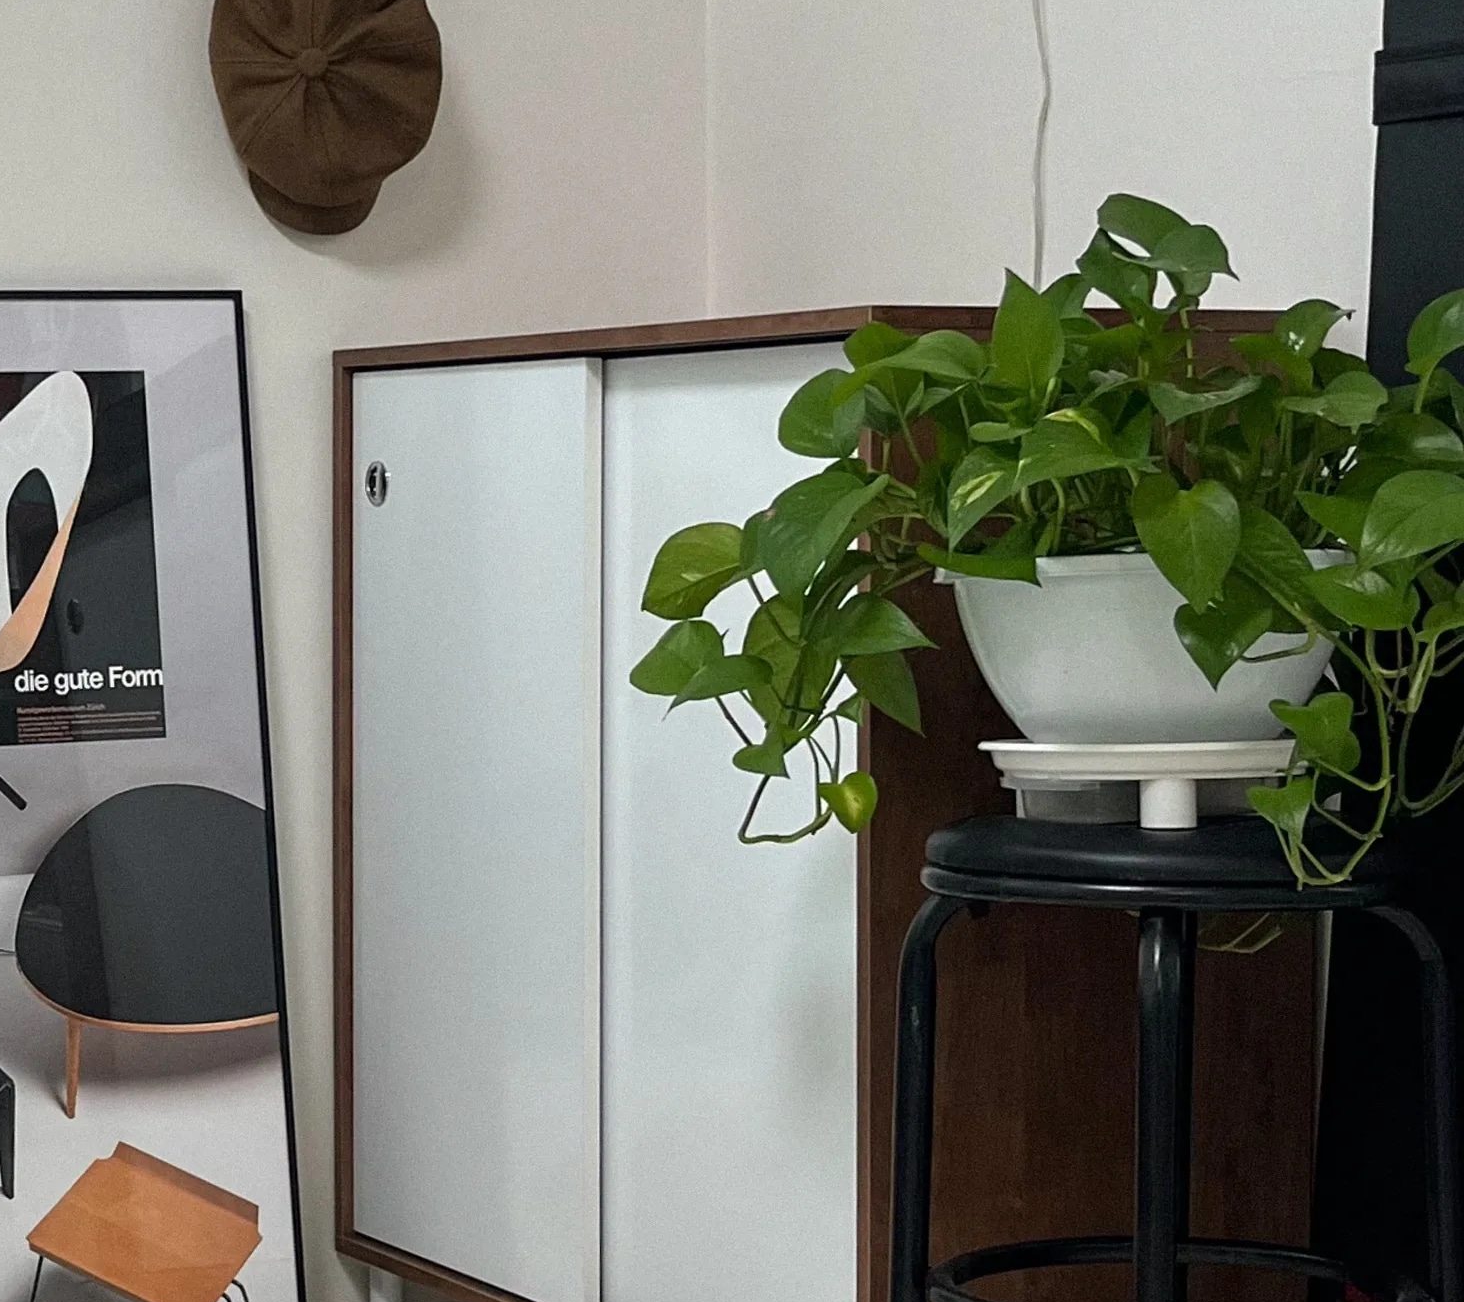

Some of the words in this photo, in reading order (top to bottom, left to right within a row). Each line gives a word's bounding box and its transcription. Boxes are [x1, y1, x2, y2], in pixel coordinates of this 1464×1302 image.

[14, 670, 49, 692] die
[54, 669, 104, 695] gute
[108, 666, 164, 688] Form
